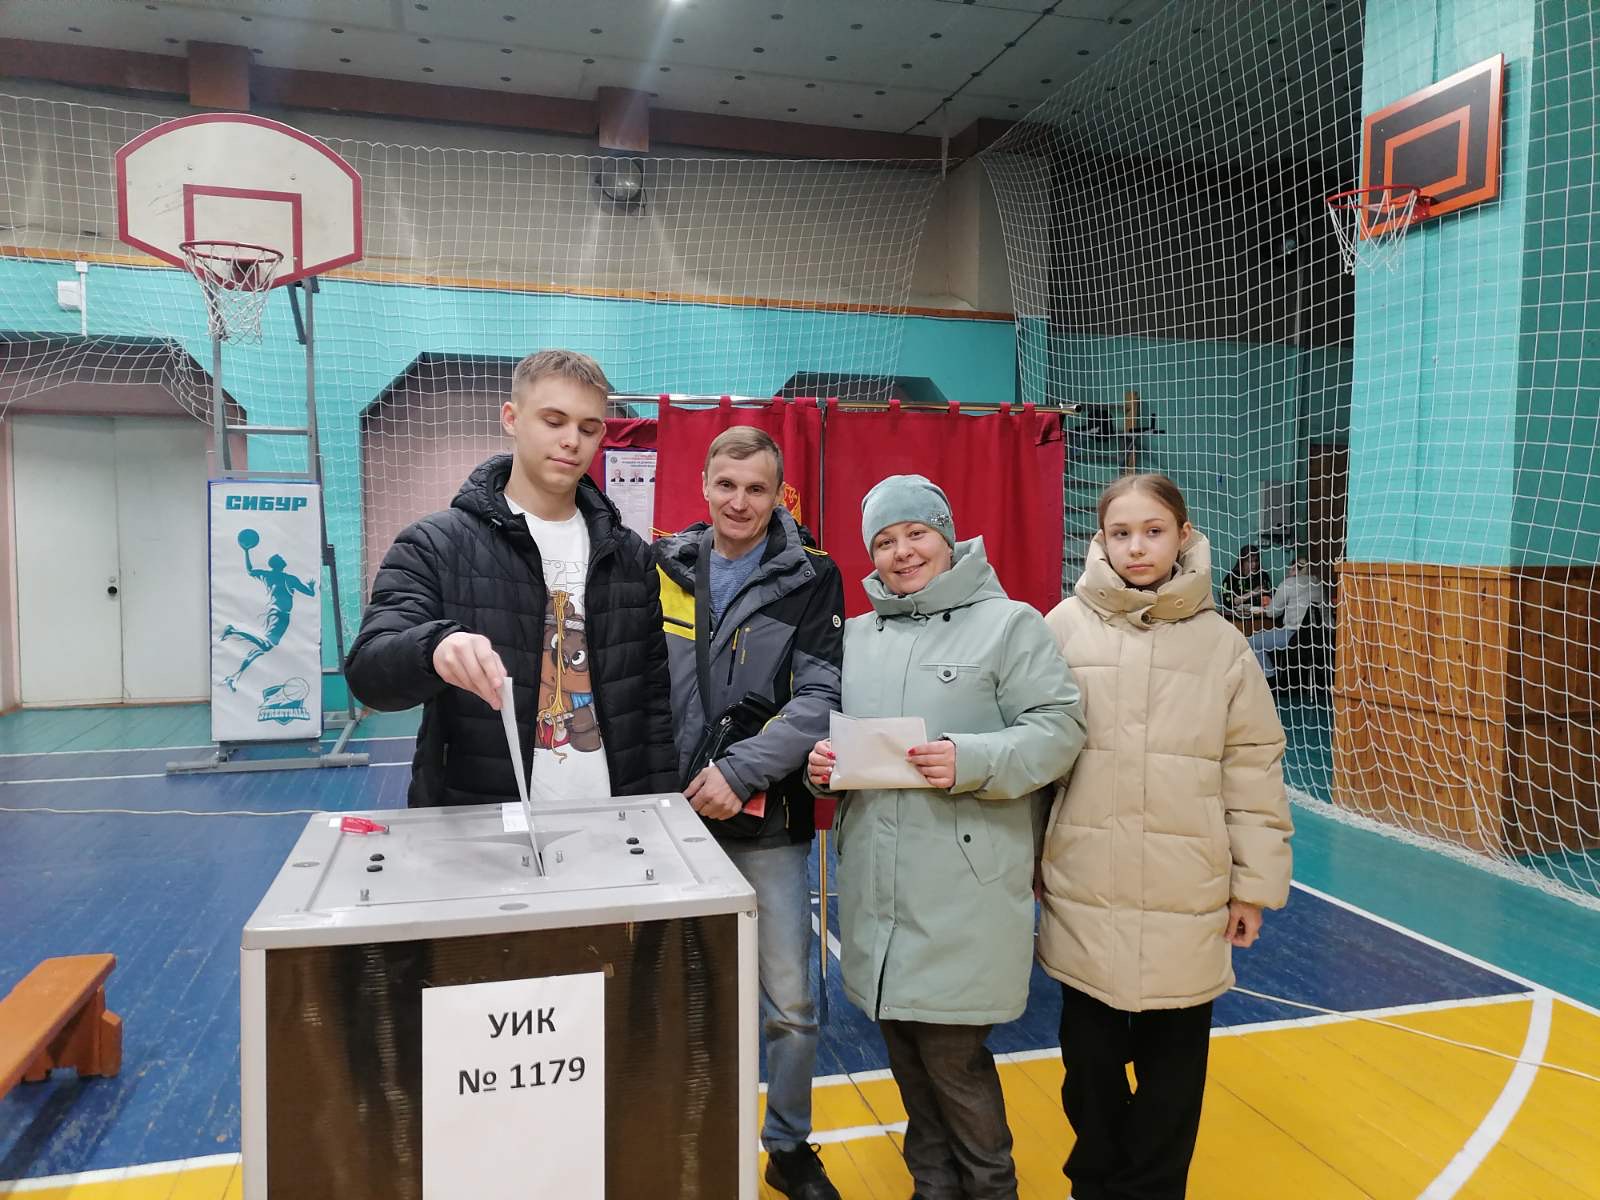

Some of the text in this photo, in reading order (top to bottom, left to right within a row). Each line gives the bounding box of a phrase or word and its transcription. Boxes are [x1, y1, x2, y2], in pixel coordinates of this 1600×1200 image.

[225, 495, 307, 511] СИБУР
[258, 708, 310, 720] STREETBALL
[488, 1007, 556, 1038] УИК
[459, 1056, 586, 1095] № 1179
